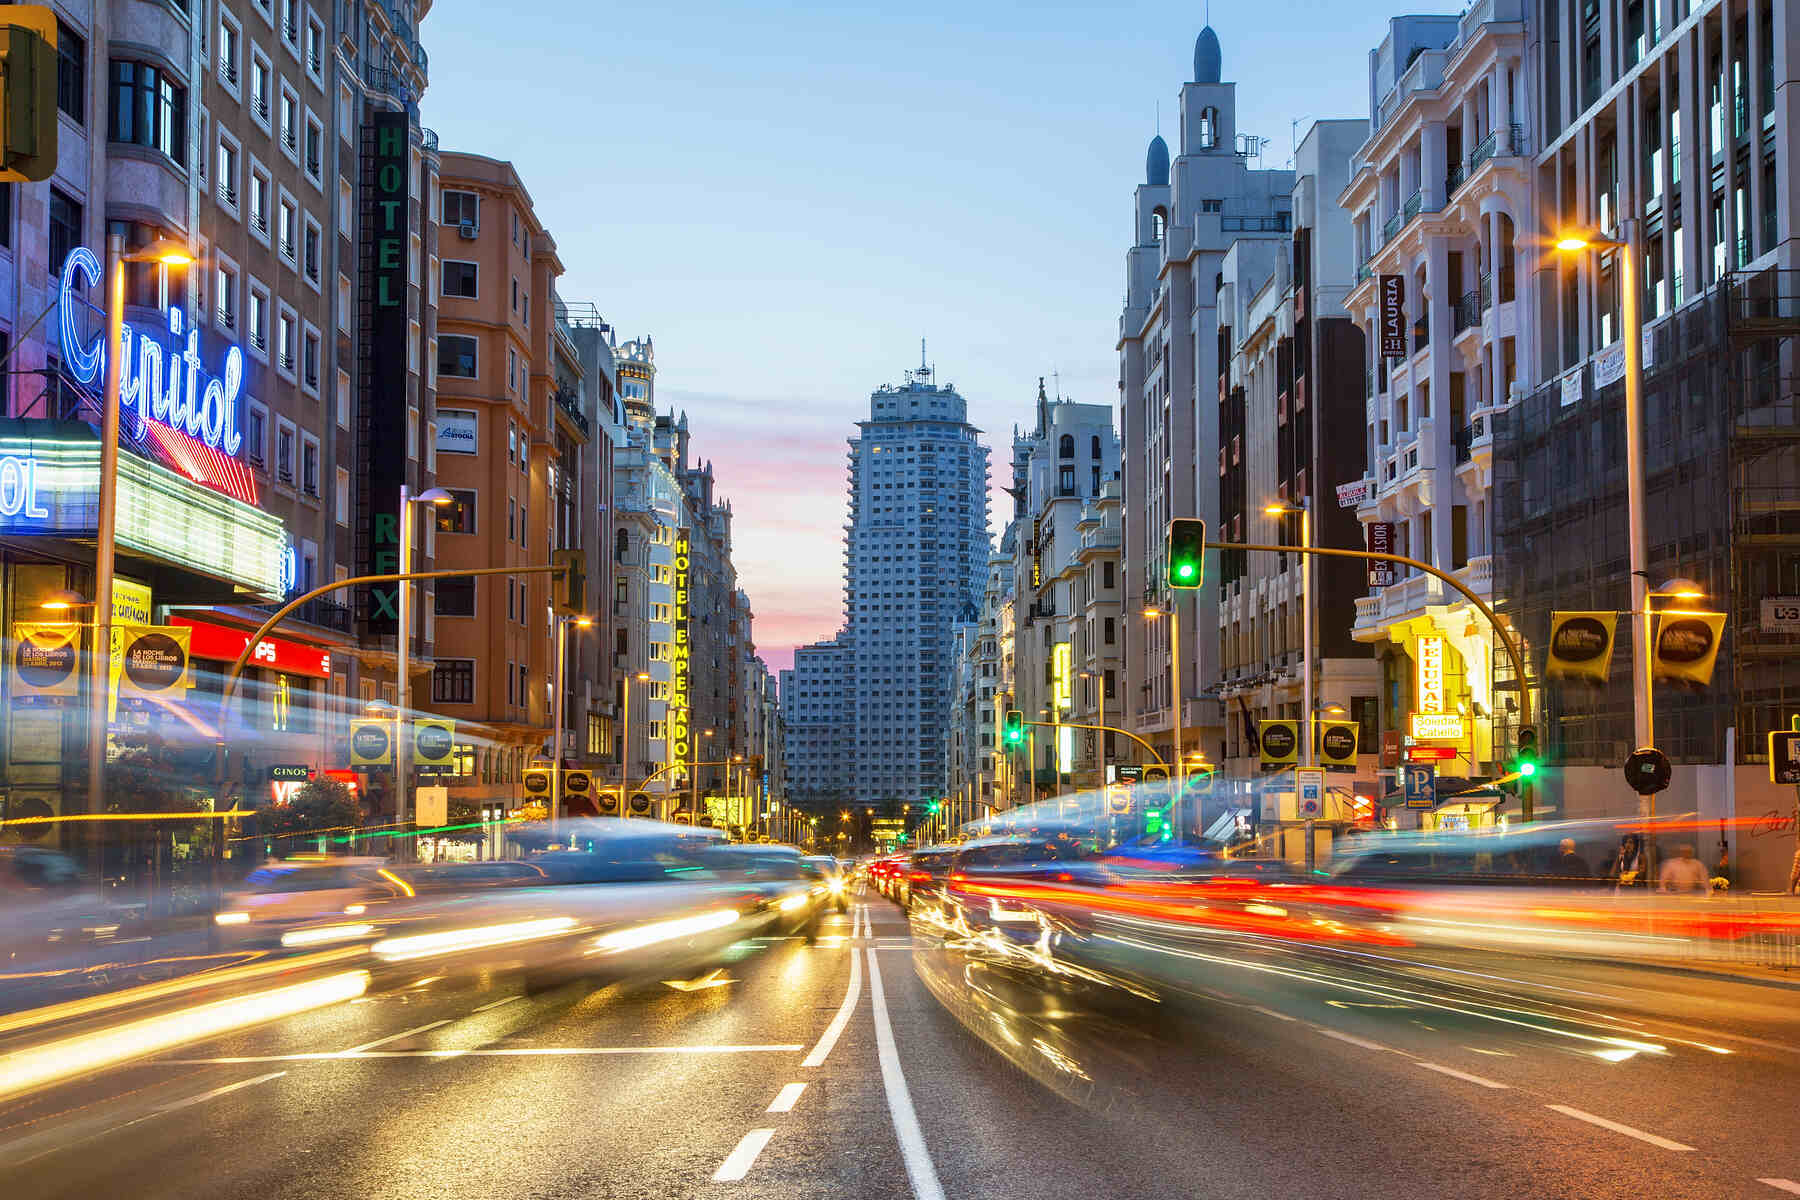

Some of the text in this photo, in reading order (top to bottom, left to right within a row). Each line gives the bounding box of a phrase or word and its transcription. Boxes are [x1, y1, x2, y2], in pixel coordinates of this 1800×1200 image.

[378, 127, 401, 307] HOTEL
[1386, 278, 1399, 337] LAURIA
[371, 513, 399, 620] REX
[1374, 524, 1388, 572] EXELSIOR
[675, 540, 688, 774] HOTEL EMPERADOR
[1423, 637, 1440, 713] PELUCAS
[273, 766, 307, 777] GINOS
[1413, 769, 1430, 795] P
